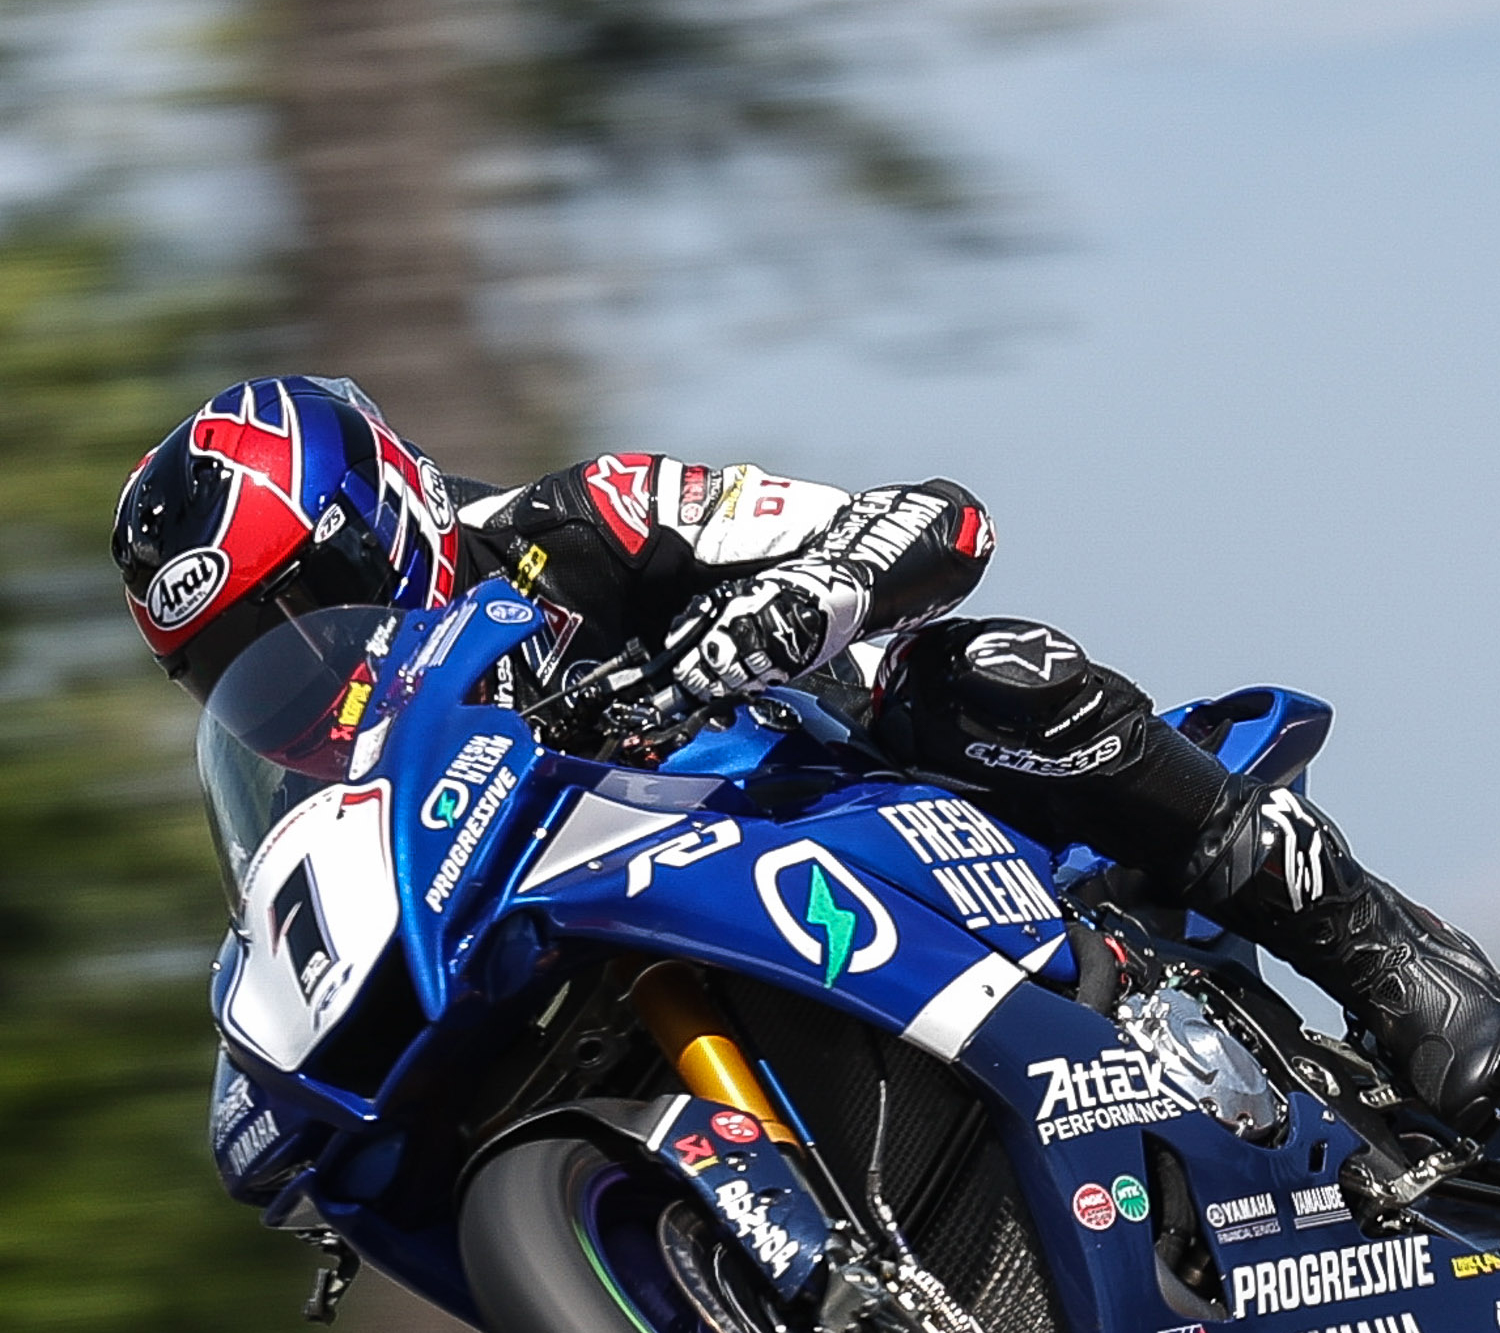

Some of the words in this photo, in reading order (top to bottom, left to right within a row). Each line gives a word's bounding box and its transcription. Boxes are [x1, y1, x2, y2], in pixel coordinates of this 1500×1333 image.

[848, 492, 949, 572] YAMAHA
[158, 553, 214, 623] Arai
[425, 766, 517, 913] PROGRESSIVE
[879, 798, 1016, 864] FRESH
[1027, 1049, 1198, 1121] Attack
[1037, 1098, 1182, 1145] PERFORMANCE
[1221, 1193, 1276, 1223] YAMAHA
[1291, 1184, 1346, 1215] YAMALUBE
[1232, 1235, 1435, 1319] PROGRESSIVE
